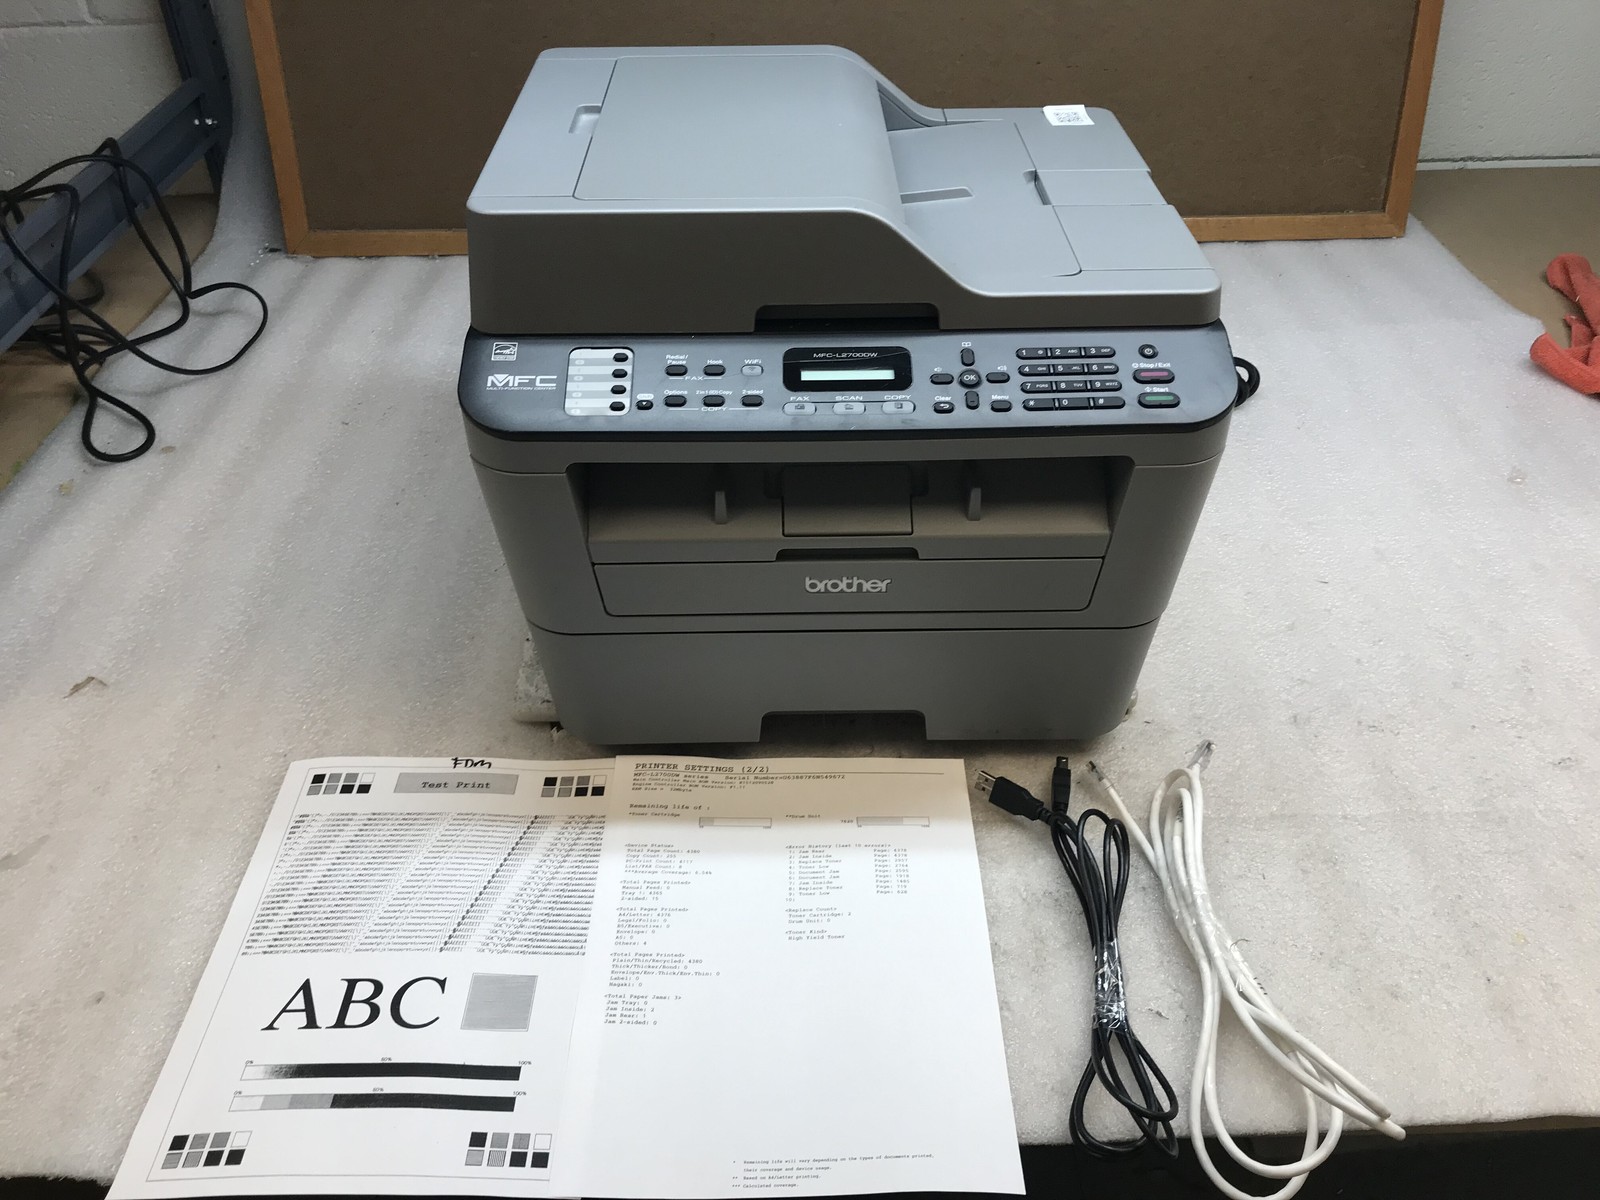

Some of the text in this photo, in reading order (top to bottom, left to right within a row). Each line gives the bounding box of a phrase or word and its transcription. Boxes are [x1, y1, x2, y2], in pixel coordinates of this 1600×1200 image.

[487, 374, 557, 387] MFC
[805, 576, 892, 592] brother
[685, 764, 734, 772] SETTINGS
[261, 976, 447, 1030] ABC
